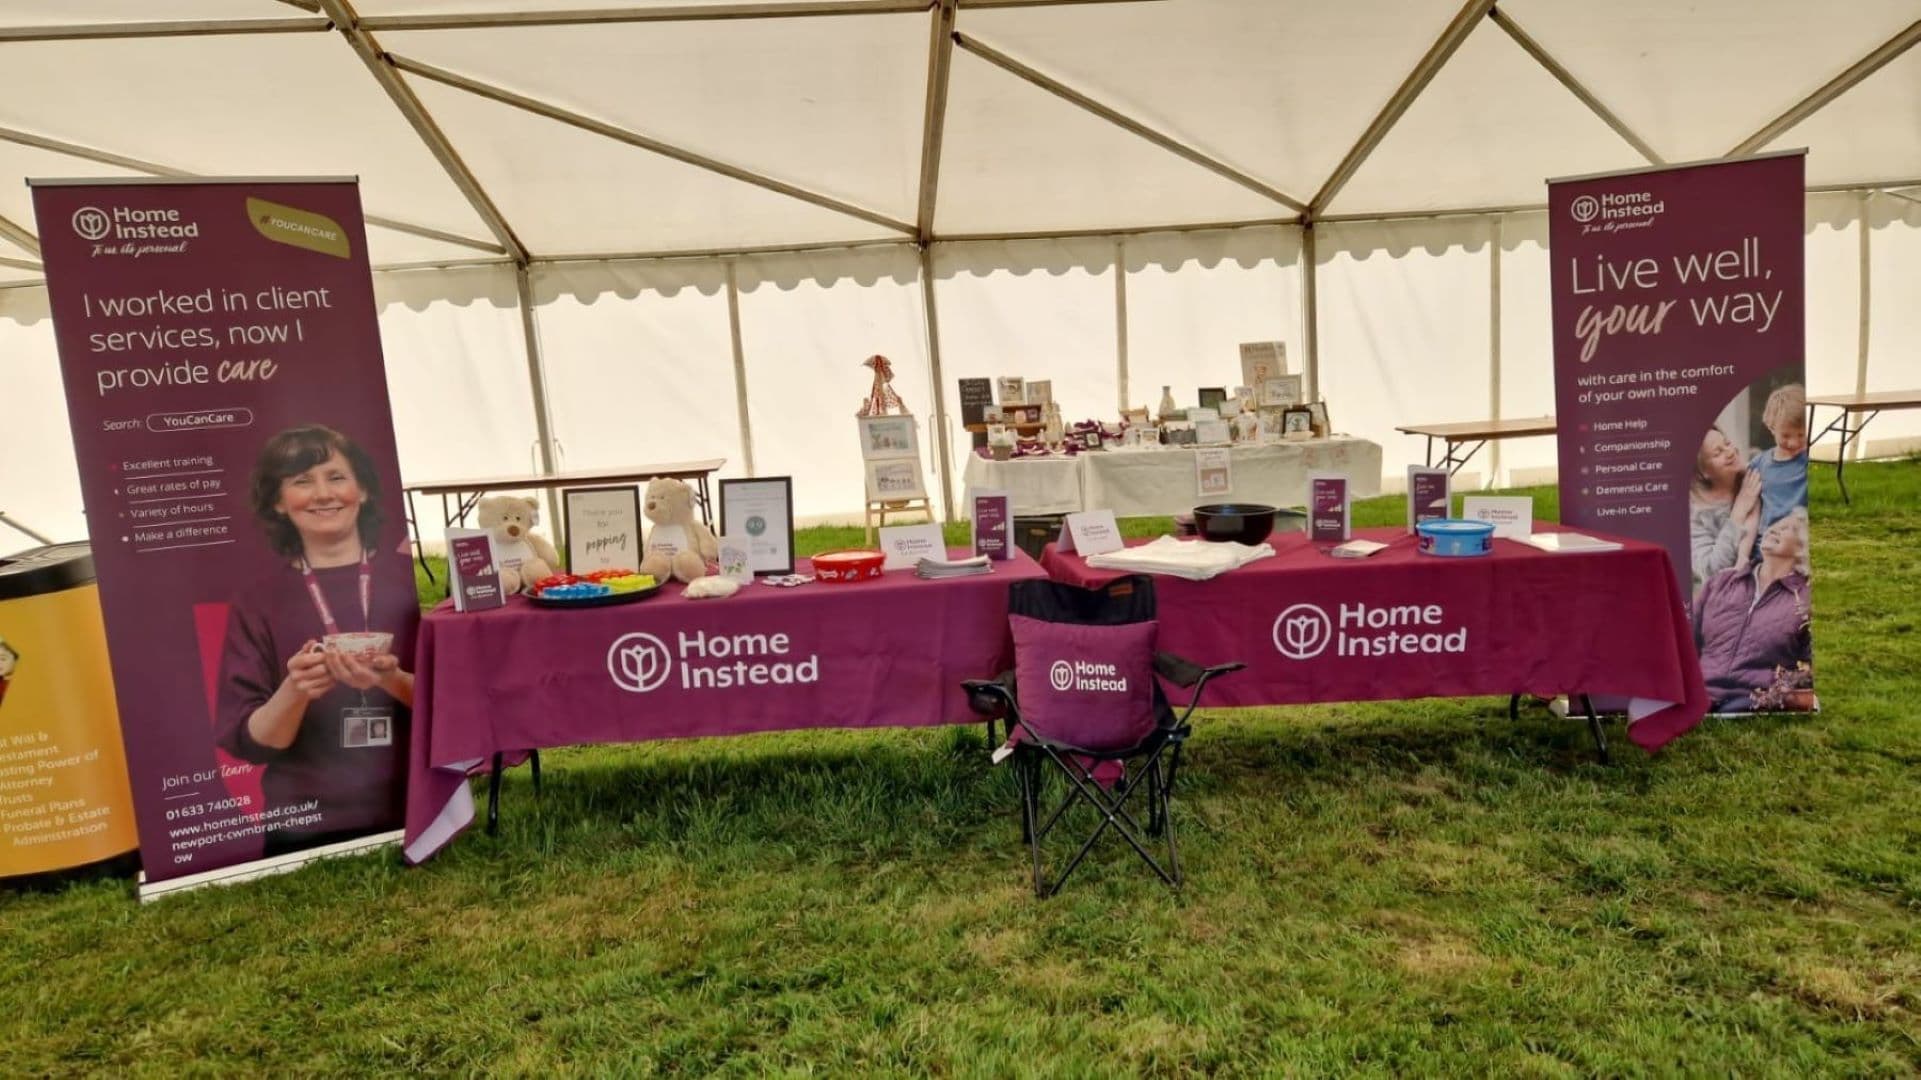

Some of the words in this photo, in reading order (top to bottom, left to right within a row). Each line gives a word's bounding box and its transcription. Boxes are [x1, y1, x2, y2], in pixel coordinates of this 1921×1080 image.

[1601, 191, 1651, 206] Home
[113, 206, 180, 223] Home
[1602, 201, 1665, 220] Instead
[116, 222, 199, 239] Instead
[260, 215, 337, 241] #YOUCANCARE
[1572, 254, 1659, 294] Live
[1673, 237, 1772, 284] well,
[84, 293, 91, 317] I
[99, 288, 213, 317] worked
[221, 288, 248, 311] in
[256, 286, 332, 310] client
[89, 325, 220, 352] services,
[228, 323, 288, 345] now
[296, 319, 304, 341] I
[1575, 299, 1677, 363] your
[1690, 290, 1783, 333] way
[96, 360, 209, 396] provide
[217, 358, 278, 383] care
[1577, 374, 1606, 387] with
[1608, 373, 1637, 385] care
[1640, 371, 1652, 382] in
[1655, 368, 1678, 381] the
[1681, 364, 1735, 379] comfort
[1578, 390, 1592, 403] of
[1594, 391, 1625, 404] your
[1627, 388, 1656, 398] own
[1659, 383, 1698, 397] home
[163, 413, 234, 427] YouCanCare
[1593, 421, 1624, 431] Home
[1625, 418, 1648, 430] Help
[1594, 439, 1671, 454] Companionship
[123, 459, 170, 471] Excellent
[173, 455, 213, 467] training
[1595, 462, 1638, 474] Personal
[1639, 461, 1663, 471] Care
[127, 483, 157, 495] Great
[160, 481, 187, 492] rates
[189, 479, 200, 490] of
[203, 479, 221, 491] pay
[1596, 484, 1643, 495] Dementia
[1644, 482, 1669, 492] Care
[130, 505, 167, 519] Variety
[170, 503, 182, 514] of
[183, 503, 214, 514] hours
[1597, 506, 1627, 517] Live-in
[1629, 504, 1652, 514] Care
[135, 531, 164, 543] Make
[167, 530, 173, 538] a
[175, 525, 228, 537] difference
[586, 532, 626, 555] popping
[1338, 602, 1444, 630] Home
[678, 630, 790, 658] Home
[1337, 627, 1468, 657] Instead
[681, 654, 820, 689] Instead
[1075, 660, 1116, 676] Home
[1076, 676, 1127, 692] Instead
[10, 734, 35, 745] Will
[0, 745, 58, 762] estament
[0, 765, 35, 777] asting
[37, 757, 81, 770] Power
[85, 750, 99, 761] of
[162, 775, 190, 791] Join
[193, 770, 216, 783] our
[1, 805, 46, 819] Funeral
[51, 799, 86, 812] Plans
[165, 804, 204, 821] 01633
[208, 795, 251, 812] 740028
[3, 819, 52, 832] Probate
[69, 807, 111, 823] Estate
[169, 800, 319, 839] www.homeinstead.co.uk/
[13, 822, 108, 846] Administration
[172, 812, 323, 852] newport-cwmbran-chepst
[174, 853, 192, 864] ow
